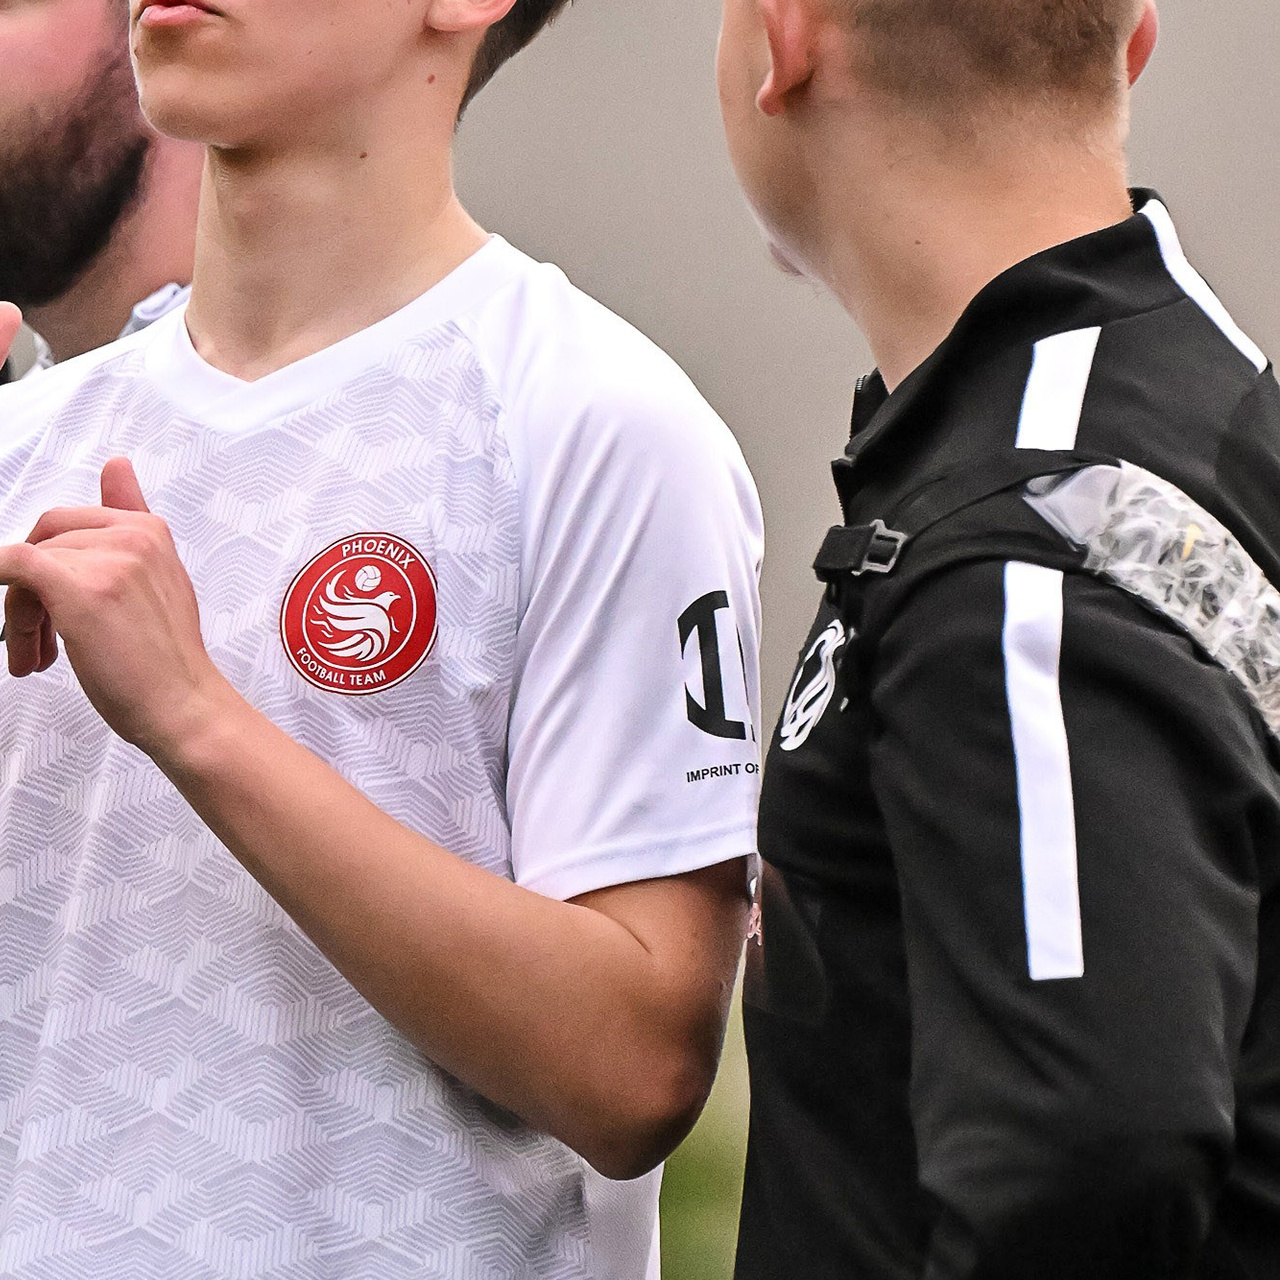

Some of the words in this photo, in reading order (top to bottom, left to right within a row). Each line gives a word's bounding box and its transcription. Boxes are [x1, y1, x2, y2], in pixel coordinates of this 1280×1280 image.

[341, 539, 415, 569] PHOENIX
[296, 647, 345, 685] FOOTBALL
[350, 669, 387, 686] TEAM
[686, 763, 741, 783] IMPRINT
